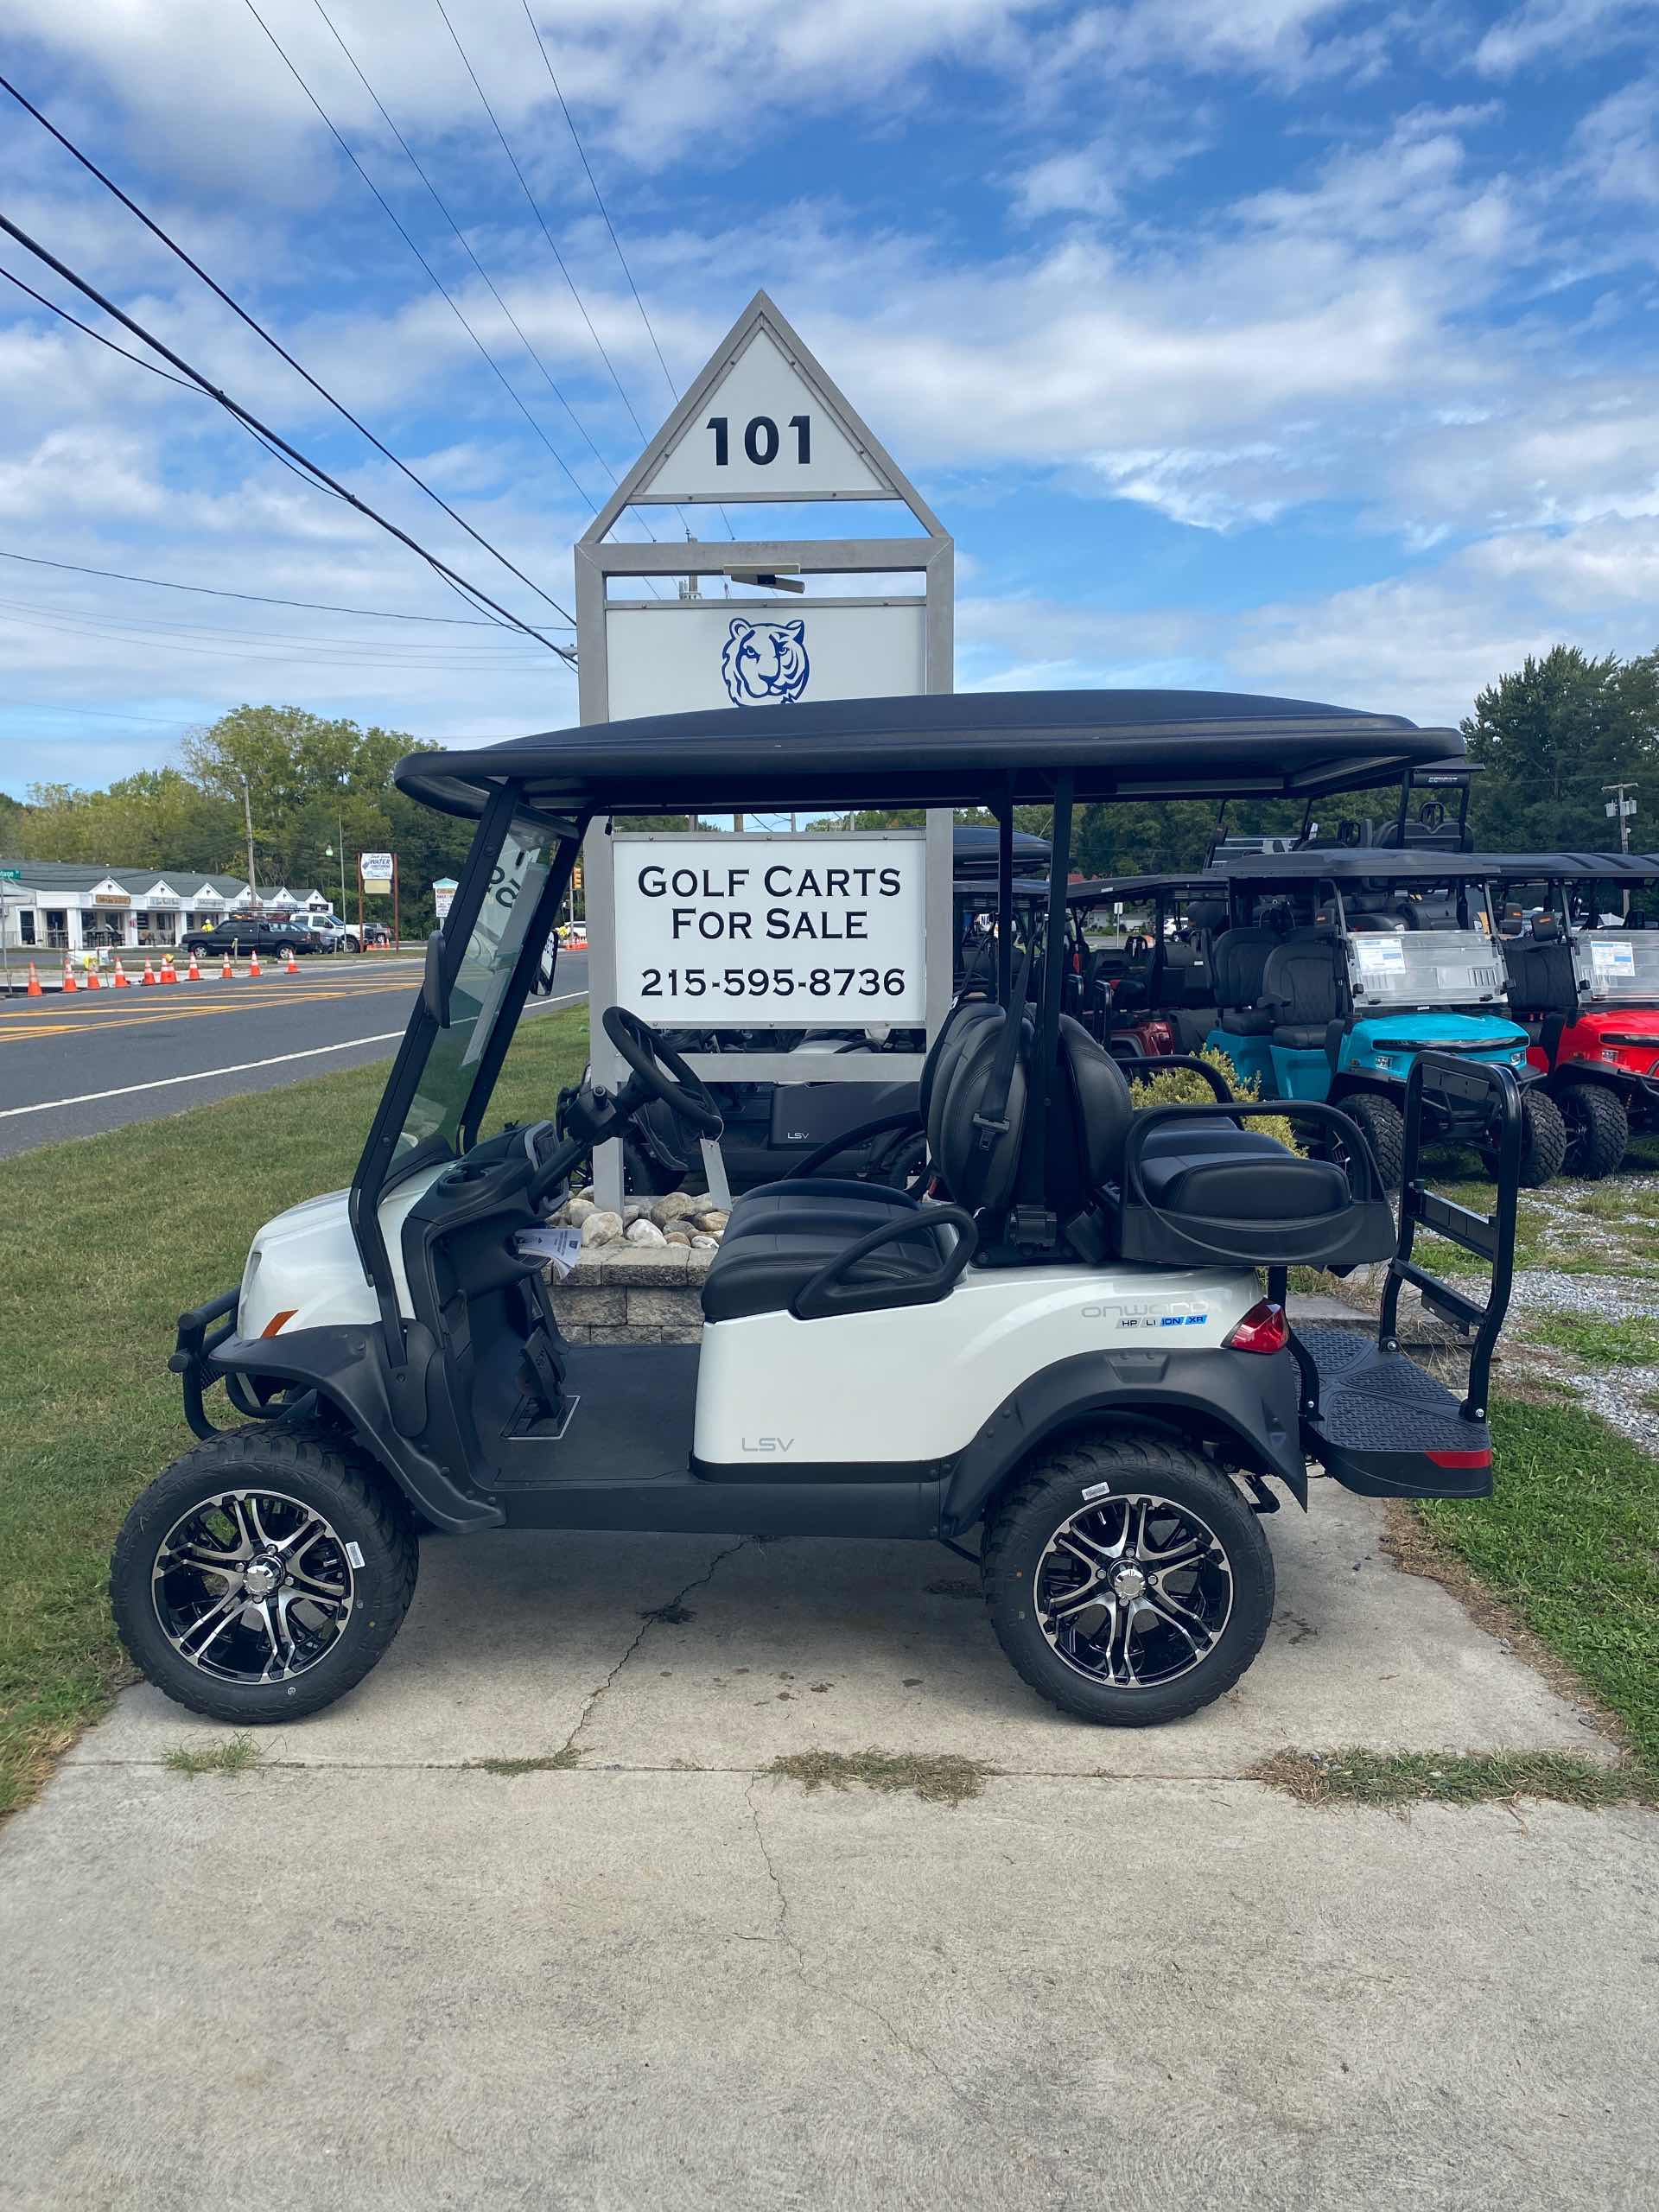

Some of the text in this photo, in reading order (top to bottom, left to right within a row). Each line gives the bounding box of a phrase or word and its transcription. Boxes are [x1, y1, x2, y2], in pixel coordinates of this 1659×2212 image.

[706, 415, 810, 466] 101
[638, 865, 901, 898] GOLF CARTS
[671, 907, 868, 940] FOR SALE
[641, 968, 906, 996] 215-595-8736
[1190, 1316, 1204, 1325] XR
[741, 1437, 795, 1452] LSV
